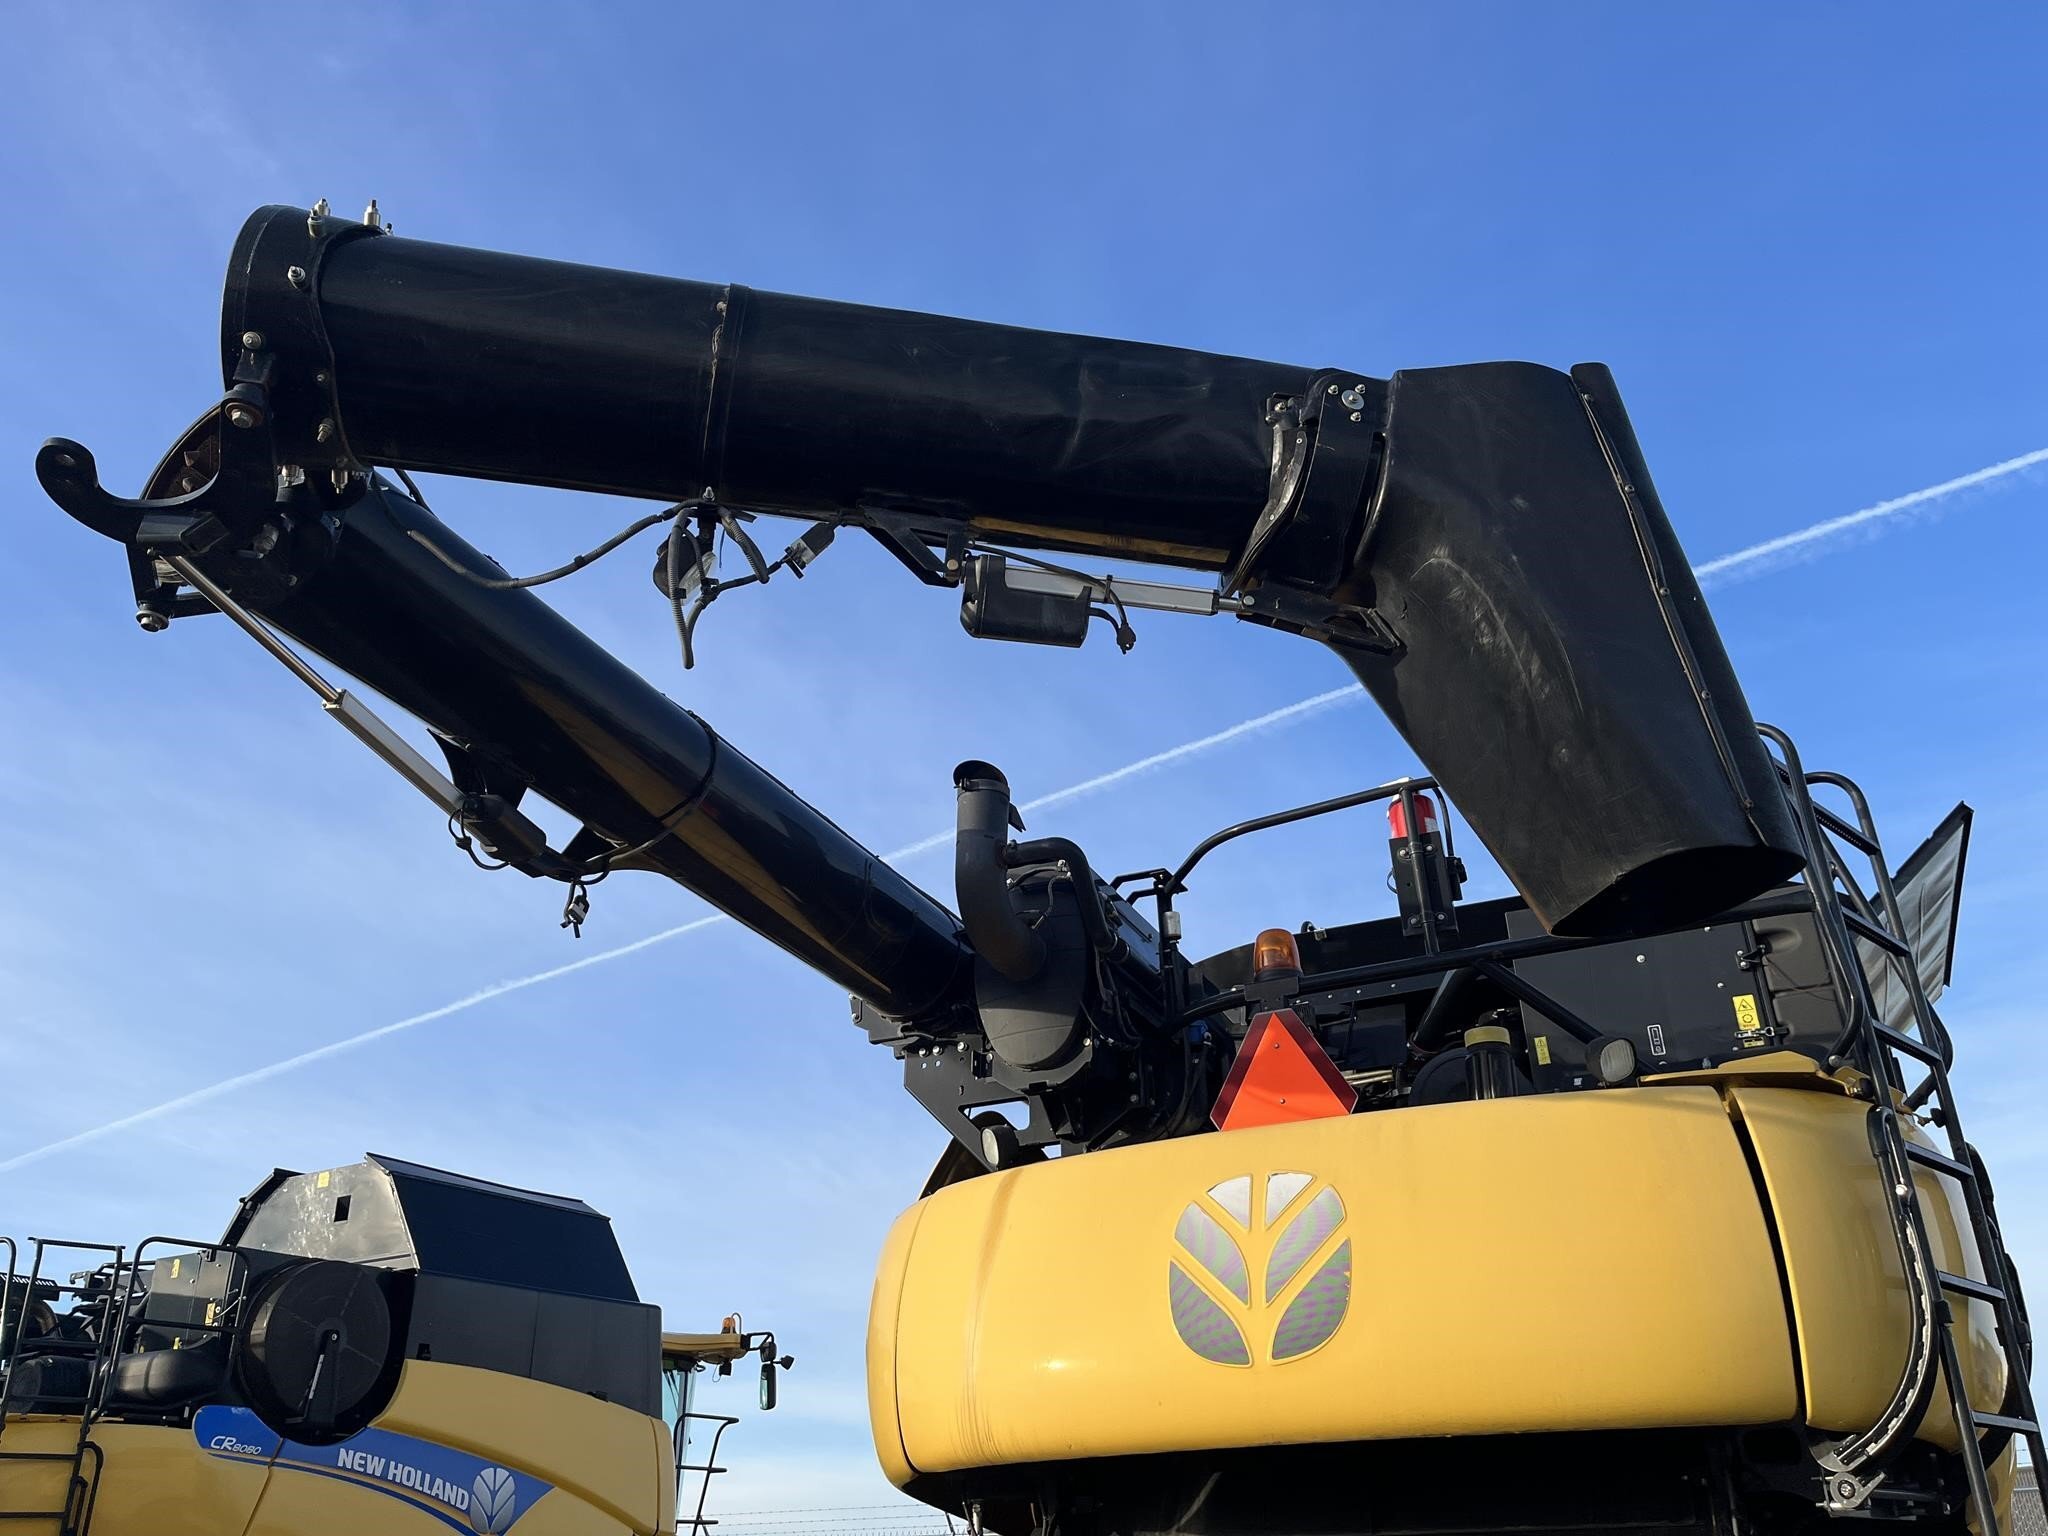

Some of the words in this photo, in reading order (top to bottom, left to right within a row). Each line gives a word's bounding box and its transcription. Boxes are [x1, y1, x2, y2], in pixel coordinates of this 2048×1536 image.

[210, 1435, 262, 1455] CR8080
[337, 1447, 386, 1477] NEW
[387, 1460, 469, 1511] HOLLAND
